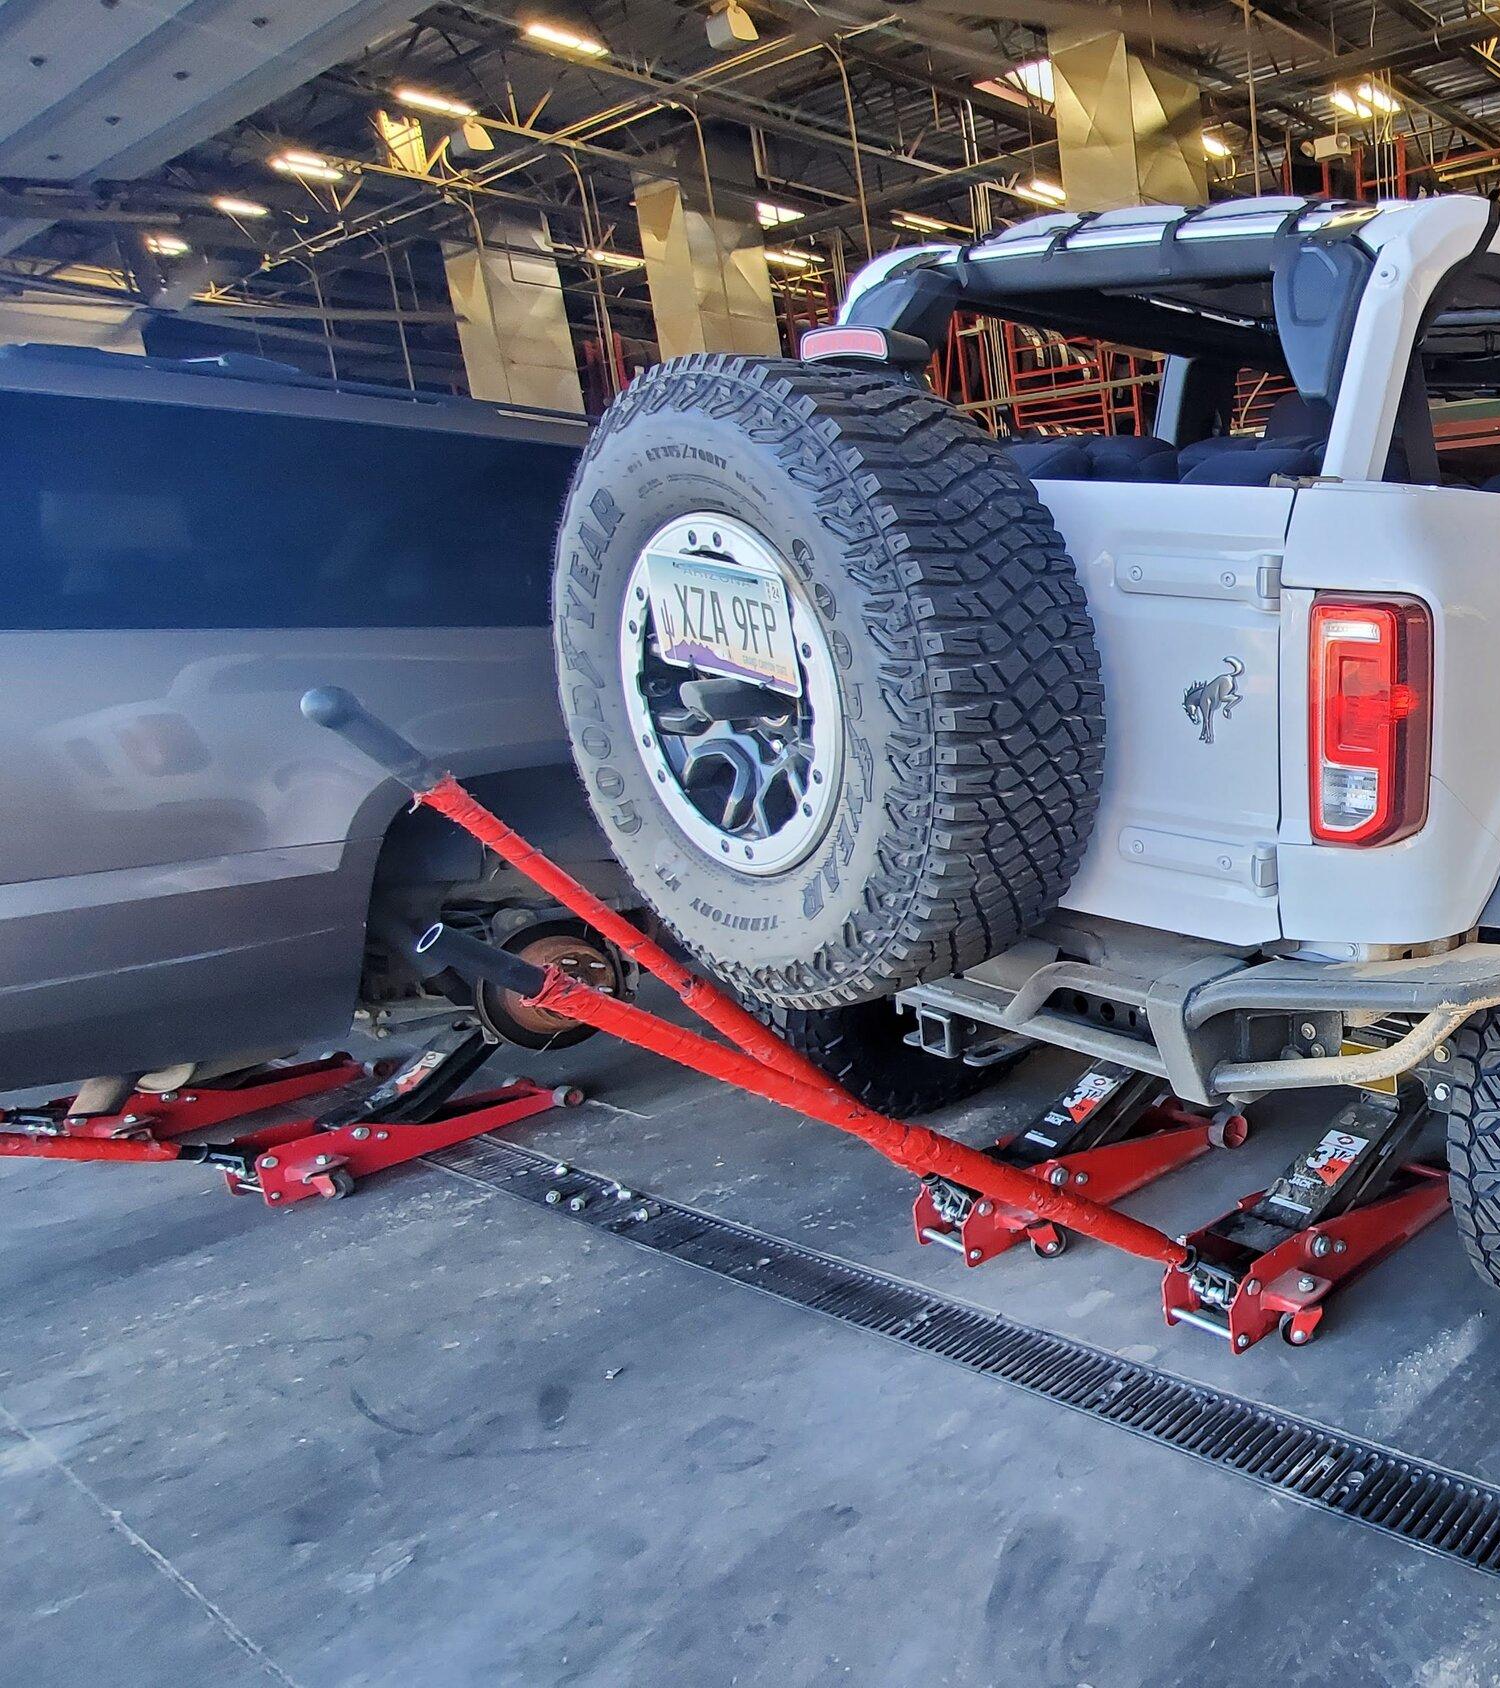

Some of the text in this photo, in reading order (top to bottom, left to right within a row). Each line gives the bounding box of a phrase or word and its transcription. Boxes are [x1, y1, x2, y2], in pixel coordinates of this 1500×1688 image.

[674, 583, 777, 659] XZA 9FP
[555, 488, 625, 836] GOODYEAR
[792, 537, 874, 922] GOODYEAR
[689, 897, 779, 932] TERRITORY
[1288, 1177, 1313, 1189] JACK
[1320, 1164, 1338, 1174] TON
